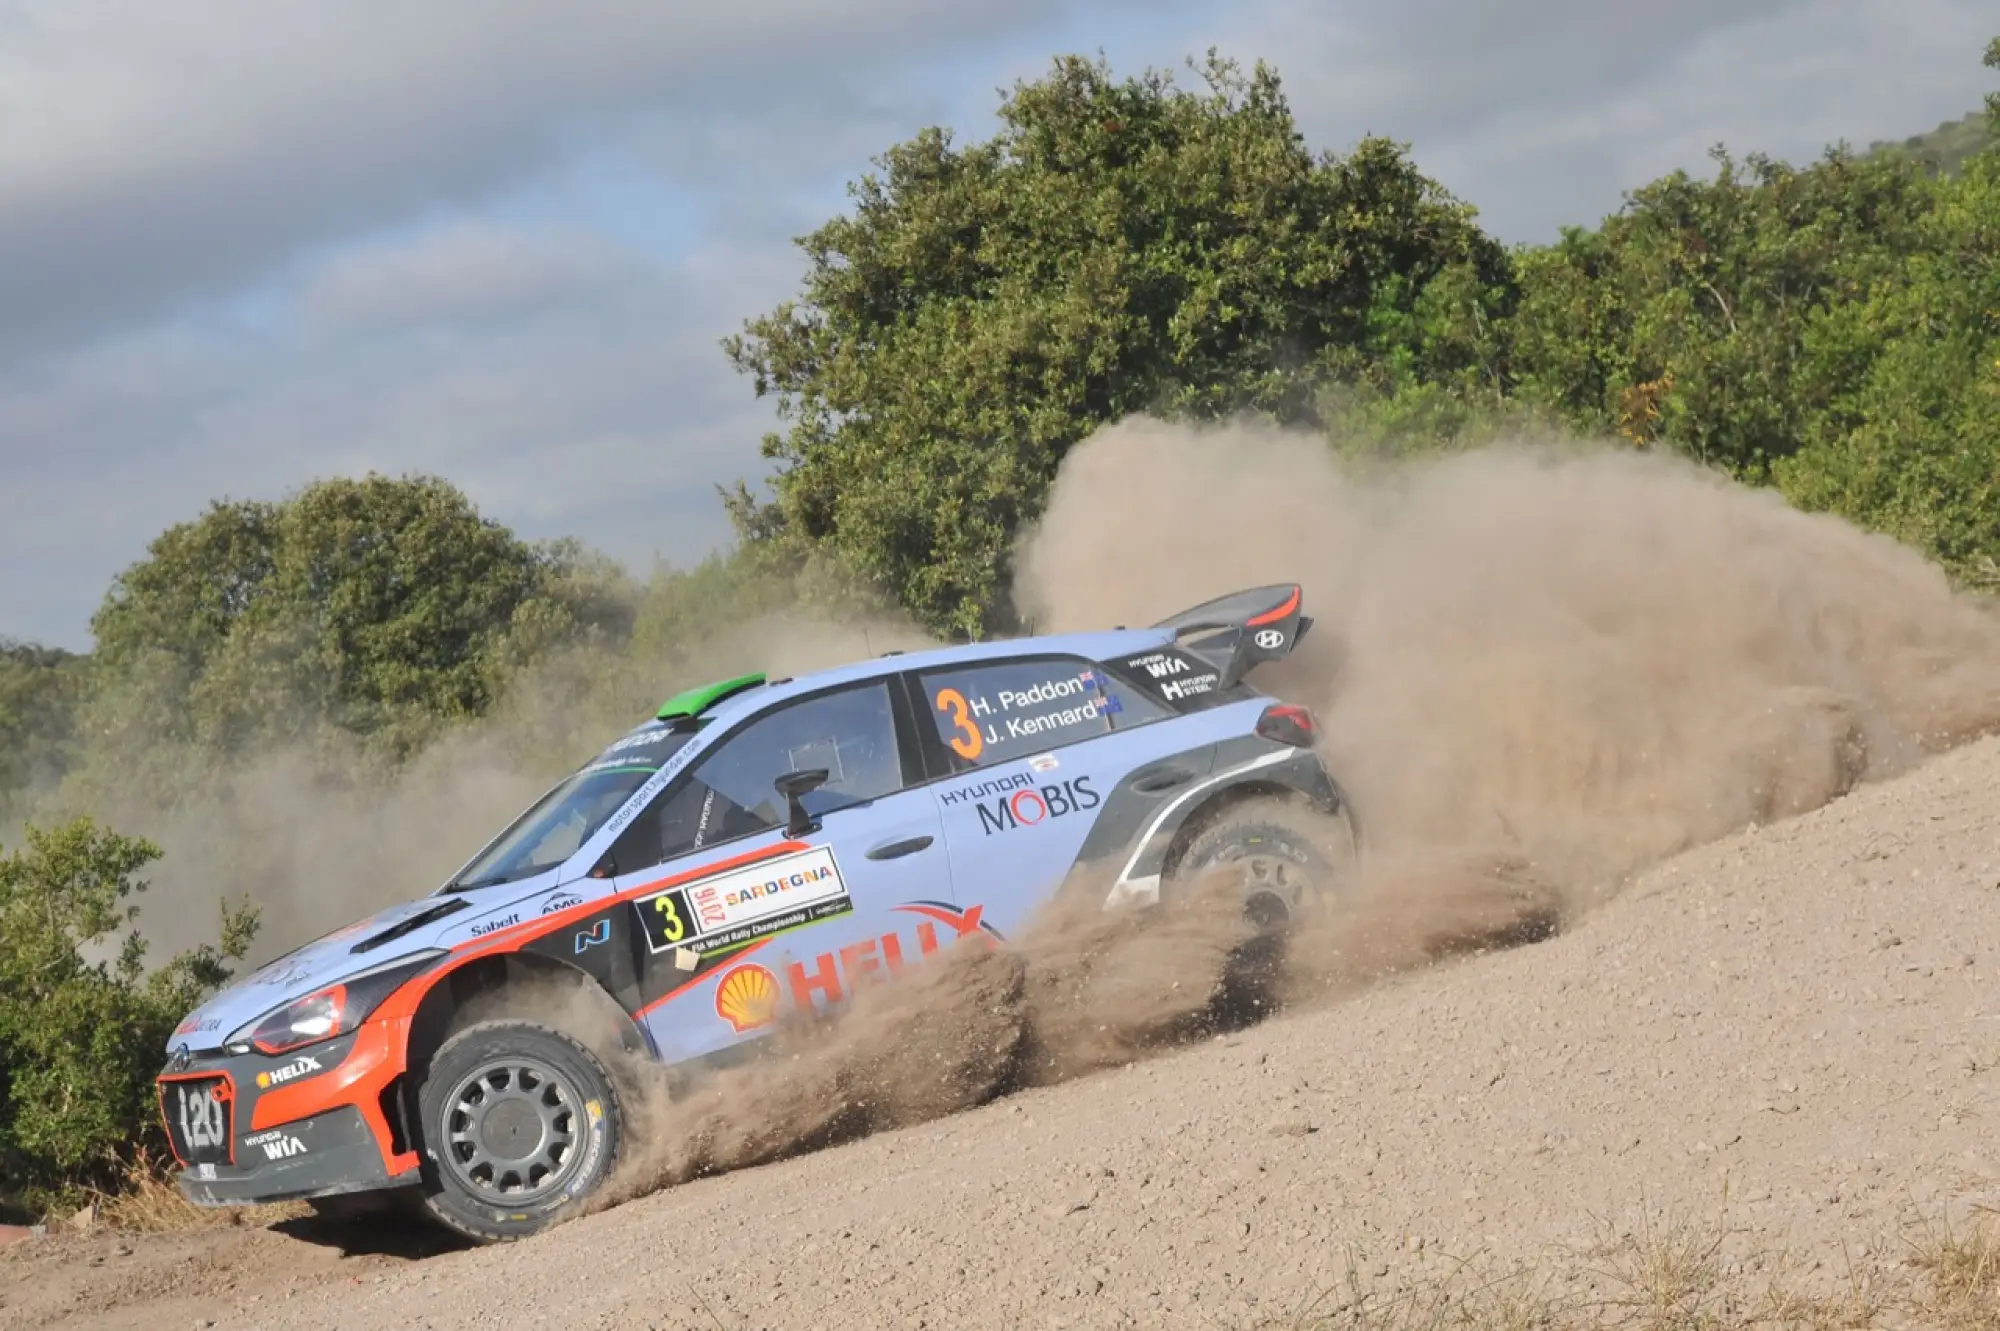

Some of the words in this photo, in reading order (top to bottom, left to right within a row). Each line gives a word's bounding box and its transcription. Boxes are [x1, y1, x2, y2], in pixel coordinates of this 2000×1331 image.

[969, 696, 997, 718] H.
[998, 676, 1084, 710] Paddon
[936, 688, 983, 760] 3
[985, 724, 1005, 744] J.
[1006, 700, 1098, 738] Kennard
[940, 771, 1035, 806] HYUNDAI
[976, 776, 1100, 836] MOBIS
[724, 866, 832, 906] SARDEGNA
[471, 913, 520, 937] Sabelt
[655, 896, 684, 942] 3
[694, 887, 726, 926] 2016
[706, 934, 730, 949] World
[731, 929, 751, 942] Rally
[752, 913, 806, 935] Championship
[269, 1056, 322, 1084] HELIX
